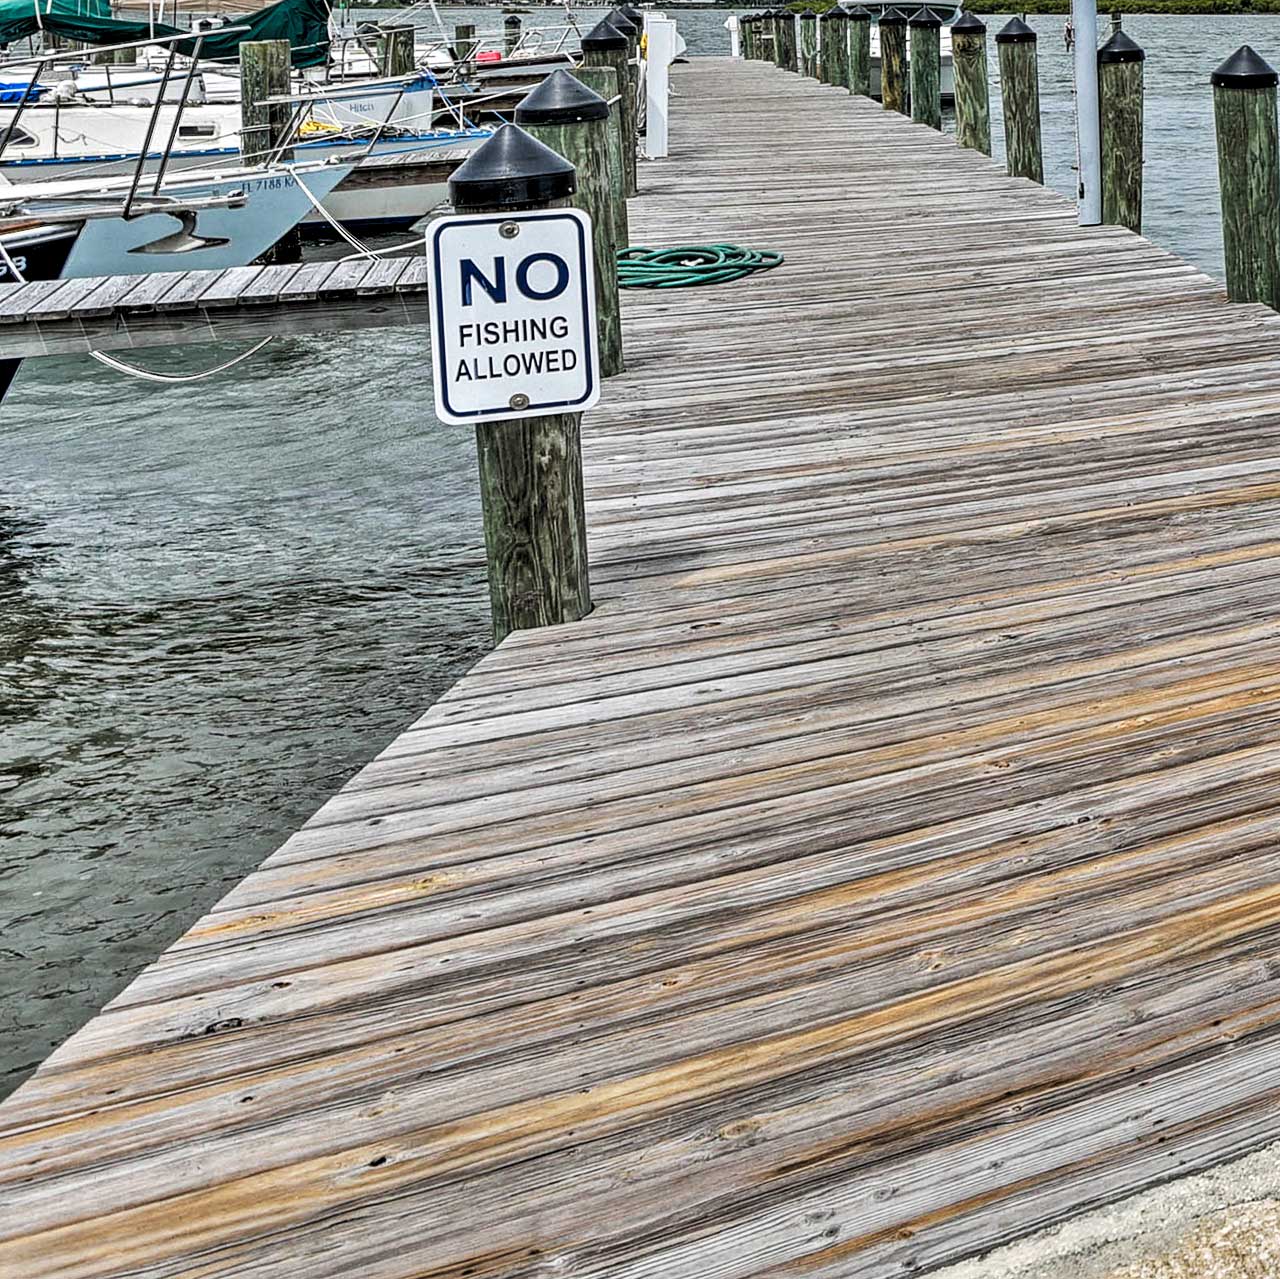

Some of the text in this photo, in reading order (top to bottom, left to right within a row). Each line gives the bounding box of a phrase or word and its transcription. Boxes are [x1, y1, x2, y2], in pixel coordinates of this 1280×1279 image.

[459, 252, 570, 307] NO
[459, 316, 569, 347] FISHING
[455, 349, 577, 382] ALLOWED
